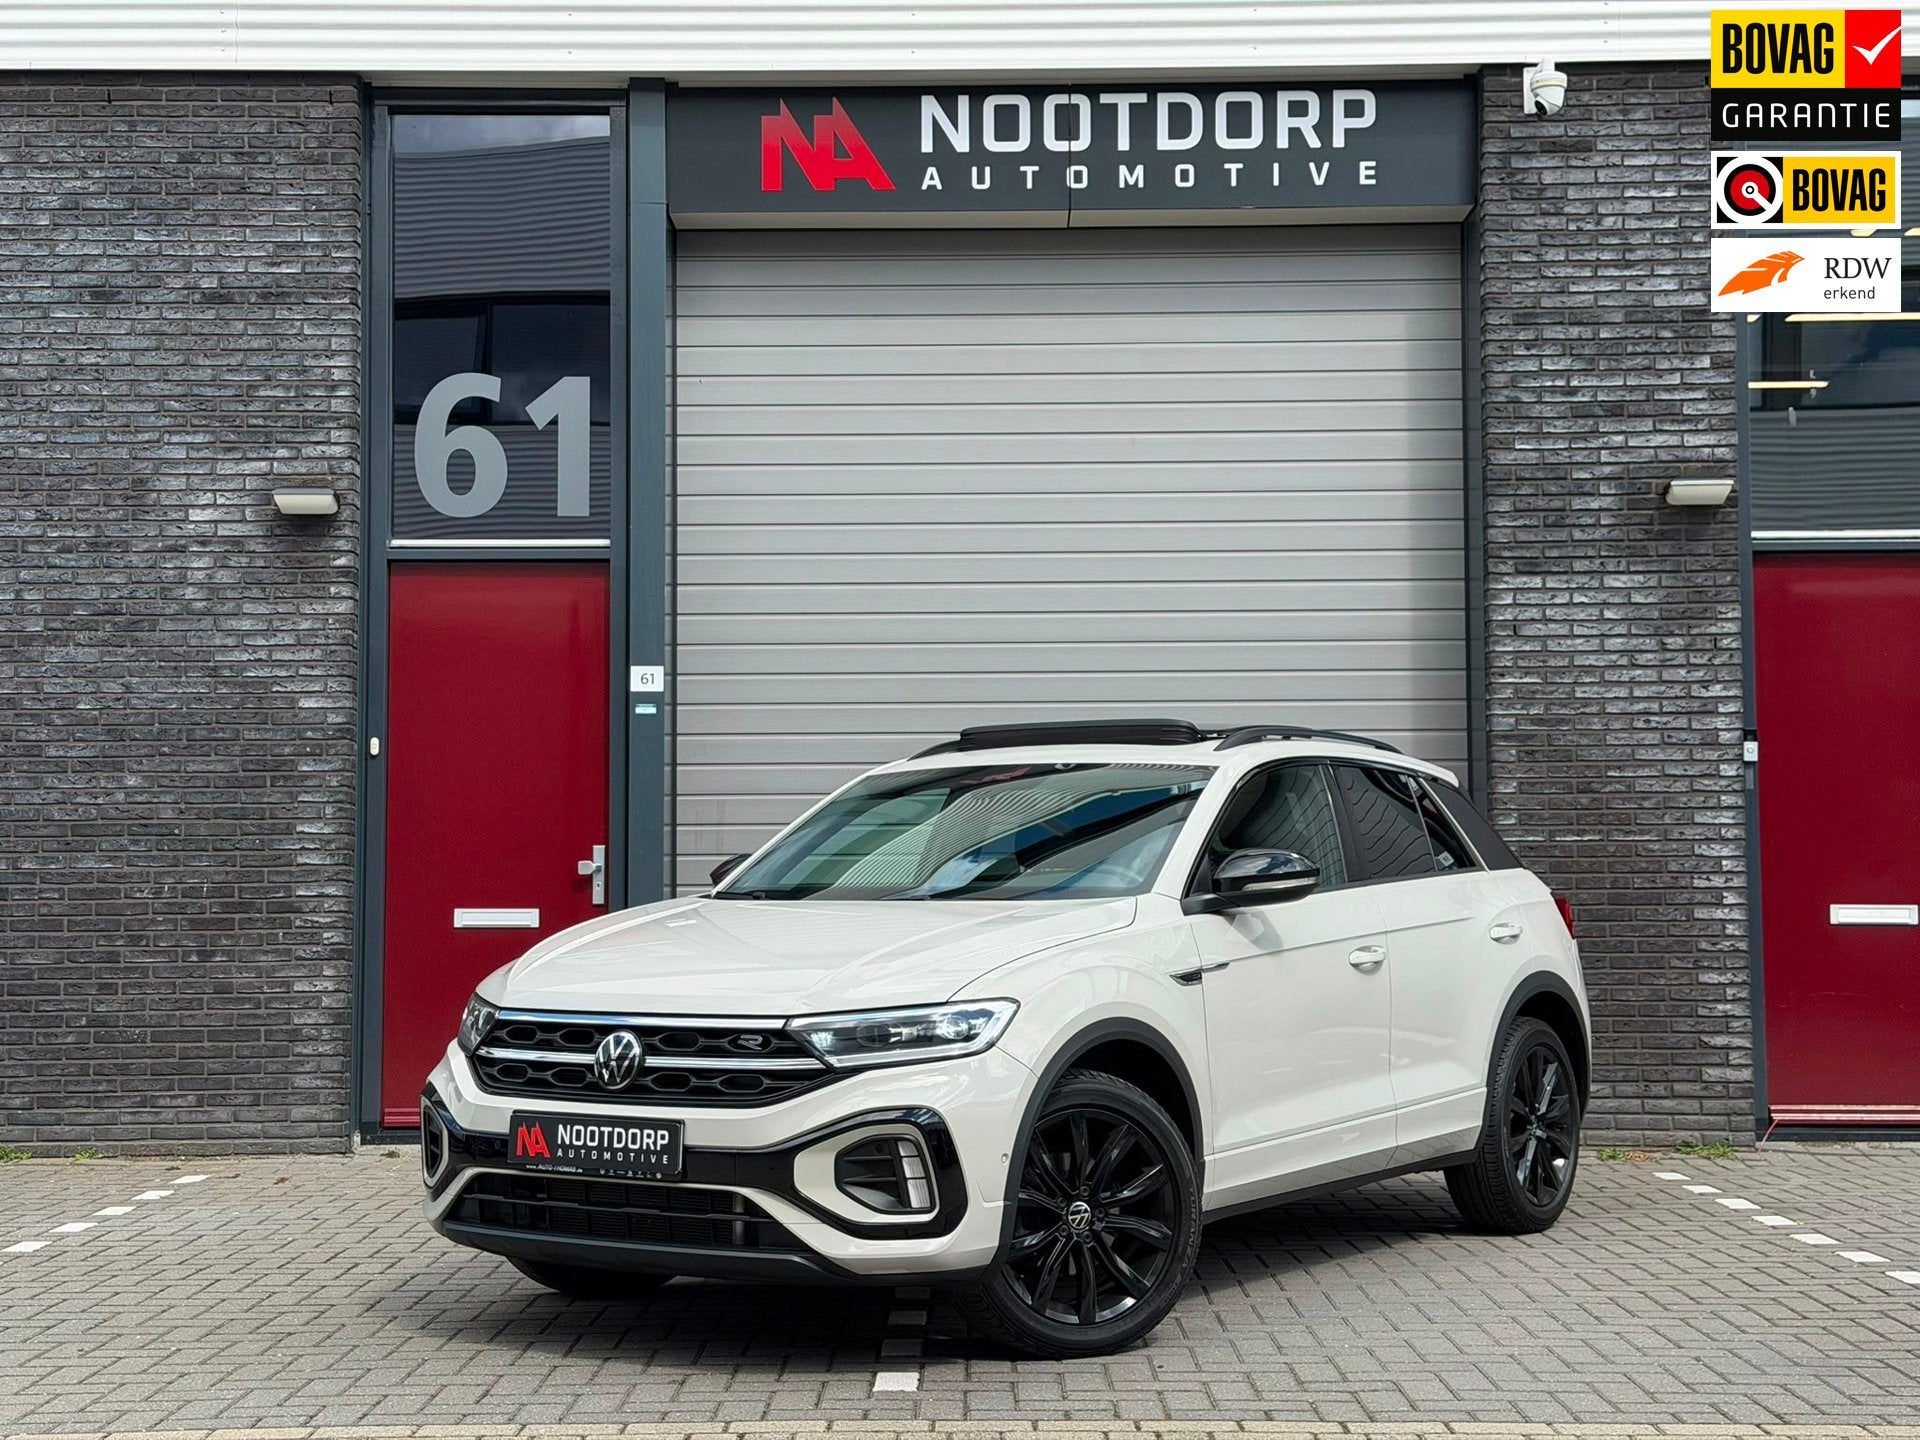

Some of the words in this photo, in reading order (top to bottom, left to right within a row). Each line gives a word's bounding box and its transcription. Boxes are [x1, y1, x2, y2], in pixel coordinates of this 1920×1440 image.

[921, 90, 1376, 152] NOOTDORP
[922, 161, 1376, 190] AUTOMOTIVE
[415, 373, 590, 517] 61
[640, 672, 655, 686] 61
[557, 1124, 669, 1151] NOOTDORP
[556, 1148, 669, 1164] AUTOMOTIVE
